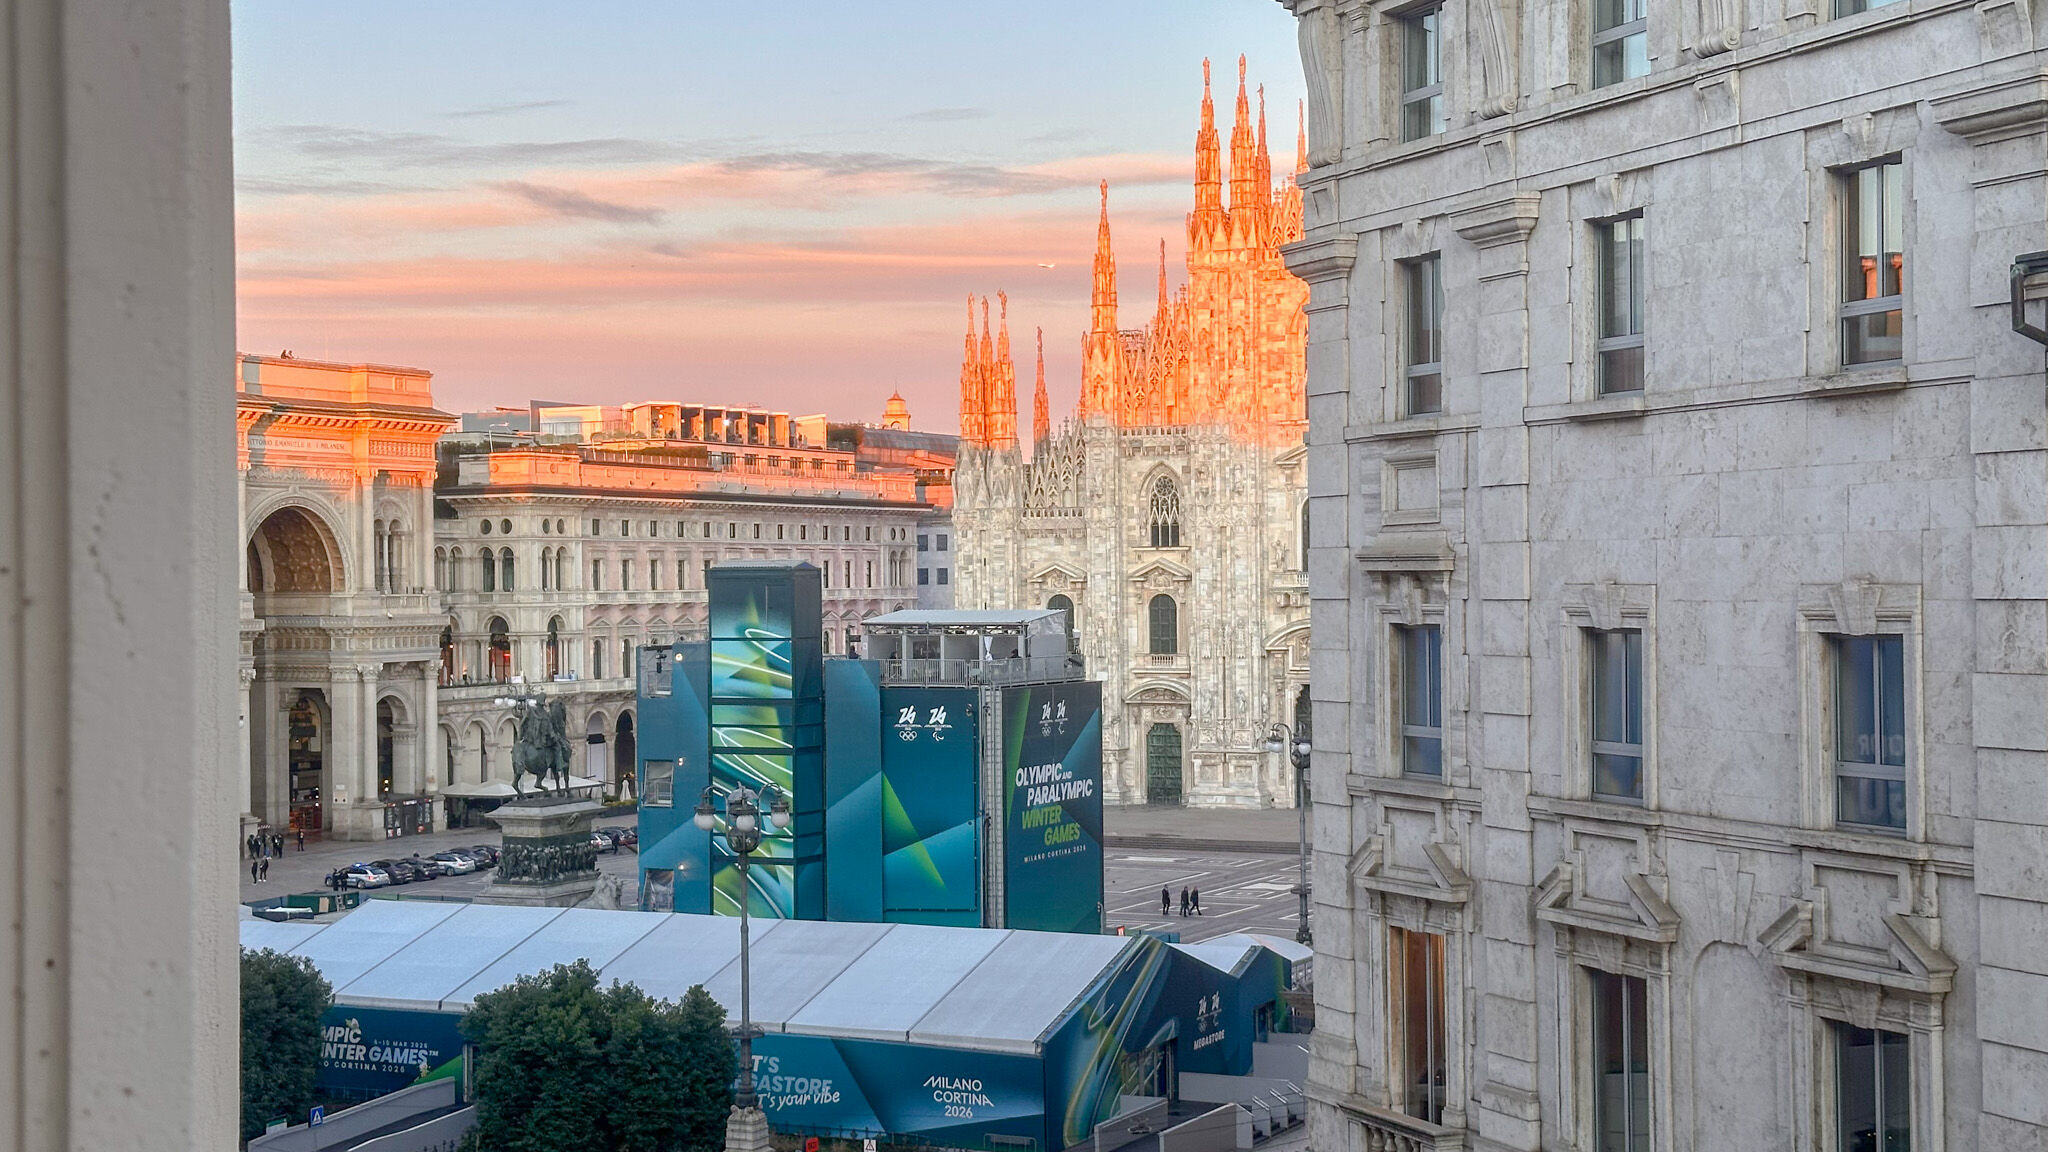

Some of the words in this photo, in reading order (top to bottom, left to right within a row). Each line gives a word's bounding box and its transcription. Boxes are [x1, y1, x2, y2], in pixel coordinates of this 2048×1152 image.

[1015, 762, 1062, 787] OLYMPIC
[1061, 770, 1073, 780] AND
[1027, 778, 1093, 807] PARALYMPIC
[1021, 804, 1062, 829] WINTER
[1044, 822, 1080, 846] GAMES
[1024, 852, 1046, 864] MILANO
[1047, 847, 1071, 858] CORTINA
[1073, 843, 1087, 853] 2026
[321, 1025, 362, 1044] MPIC
[1193, 1029, 1225, 1051] MEGASTORE
[320, 1042, 367, 1061] INTER
[334, 1061, 377, 1071] CORTINA
[382, 1064, 405, 1073] 2026
[751, 1054, 780, 1074] T'S
[922, 1075, 983, 1091] MILANO
[777, 1093, 811, 1111] your
[813, 1087, 840, 1105] vibe
[933, 1090, 995, 1107] CORTINA
[944, 1105, 973, 1119] 2026
